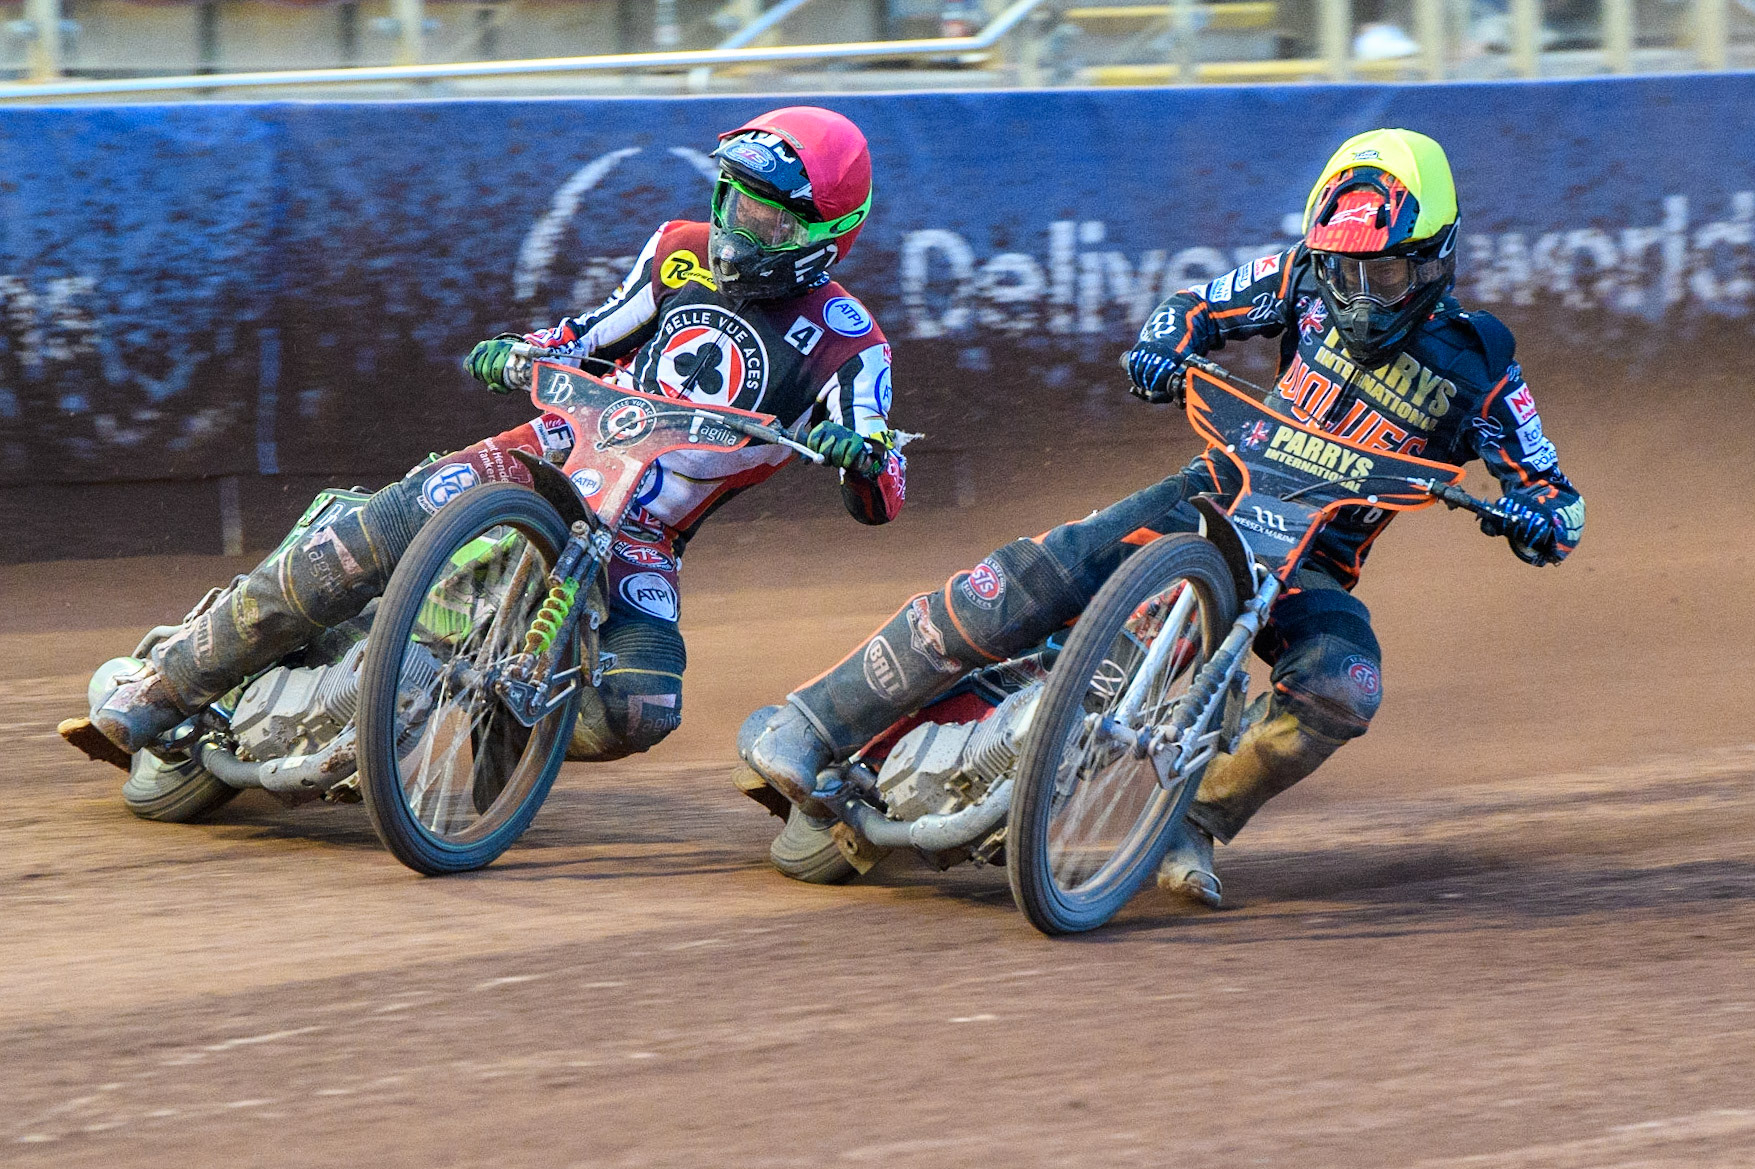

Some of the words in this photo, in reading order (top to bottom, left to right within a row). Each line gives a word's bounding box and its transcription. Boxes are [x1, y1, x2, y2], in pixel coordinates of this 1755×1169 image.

[835, 303, 864, 327] ATPI
[790, 325, 817, 351] 4
[664, 313, 712, 336] BELLE
[718, 317, 749, 343] VUE
[743, 347, 761, 391] ACES
[700, 425, 738, 446] agilia
[1270, 425, 1374, 479] PARRYS
[574, 476, 599, 490] ATPI
[1232, 514, 1266, 534] WESSEX
[1264, 528, 1297, 545] MARINE
[971, 568, 996, 593] STS
[636, 587, 672, 604] ATPI
[1354, 668, 1376, 690] STS
